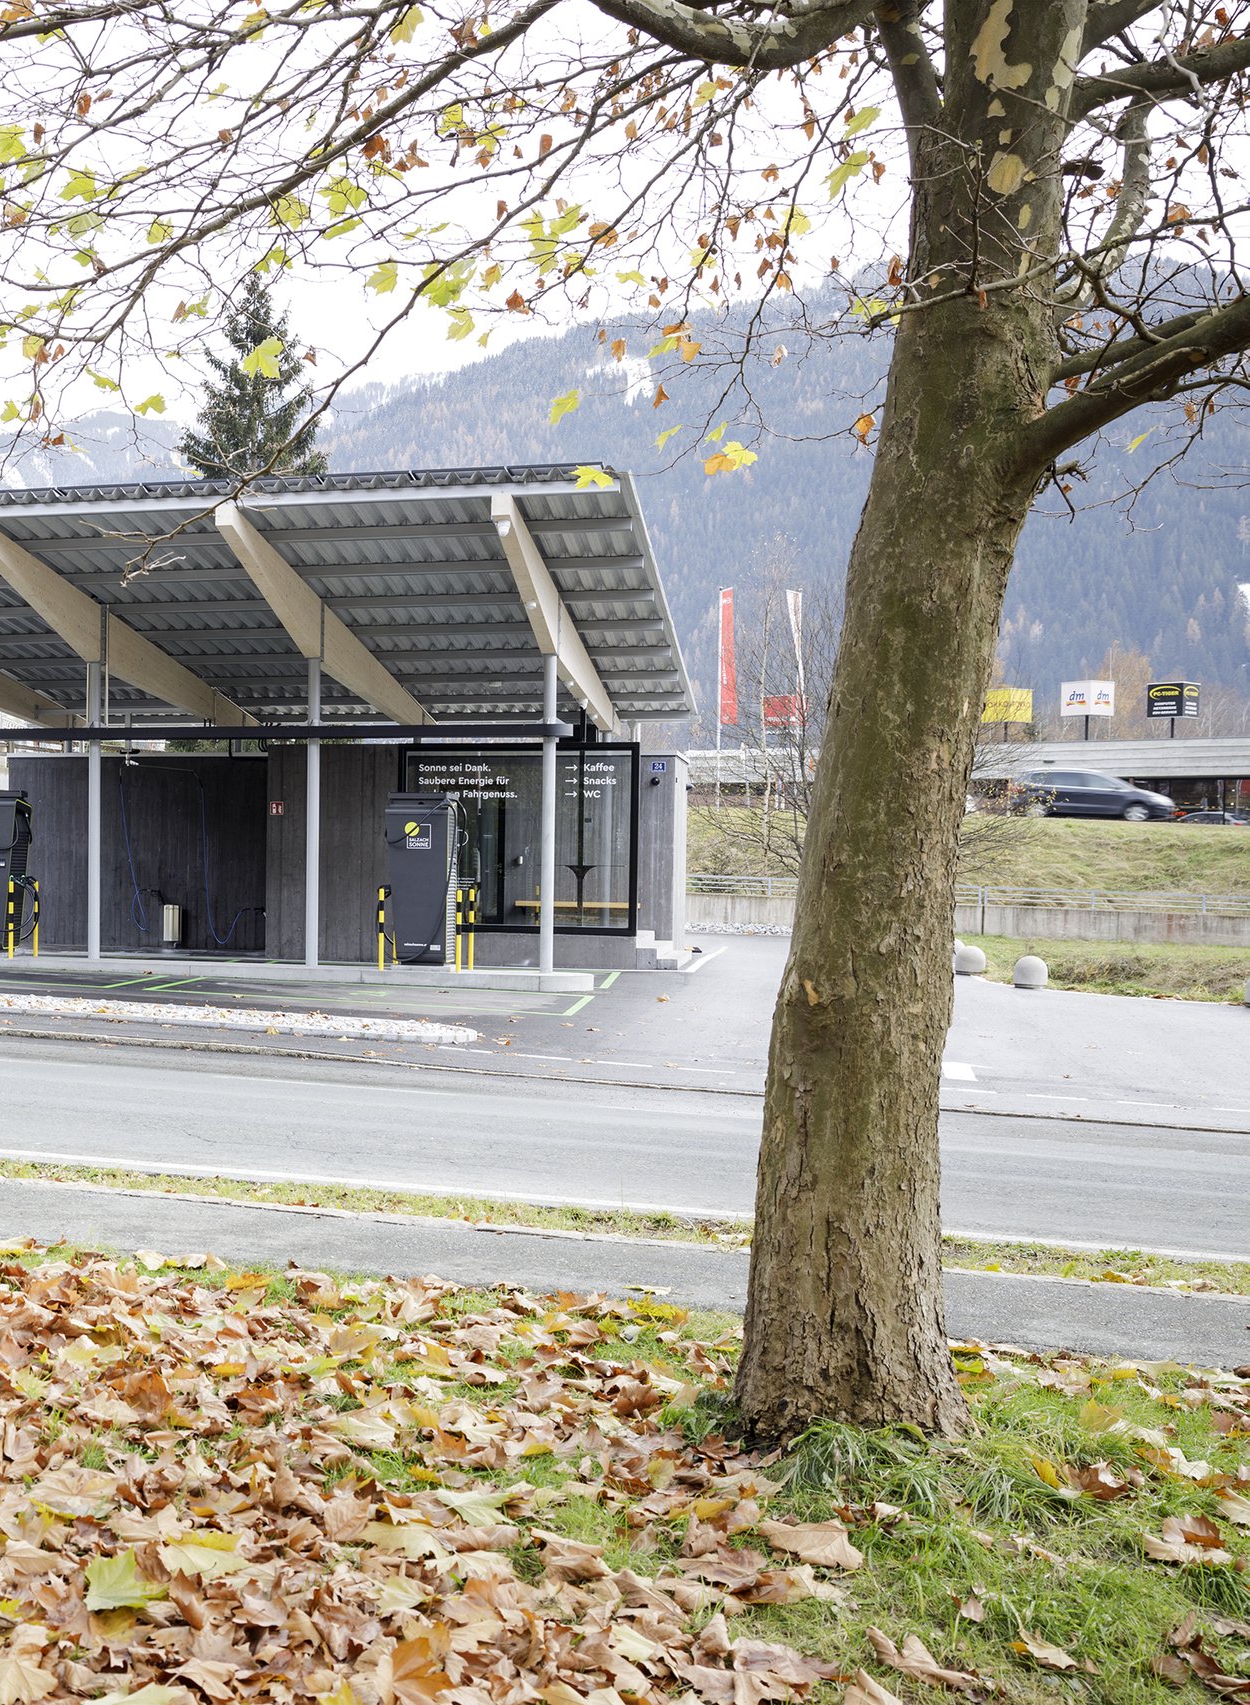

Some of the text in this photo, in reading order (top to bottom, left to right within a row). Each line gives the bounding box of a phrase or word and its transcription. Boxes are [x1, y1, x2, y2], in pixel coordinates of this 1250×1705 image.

[1069, 690, 1085, 701] dm
[1096, 690, 1110, 701] dm
[418, 763, 491, 772] Sonne sei Dank.
[583, 763, 615, 772] Kaffee
[418, 776, 510, 786] Saubere Energie für
[583, 776, 617, 785] Snacks
[463, 790, 518, 800] Fahrgenuss.
[583, 790, 601, 798] WC
